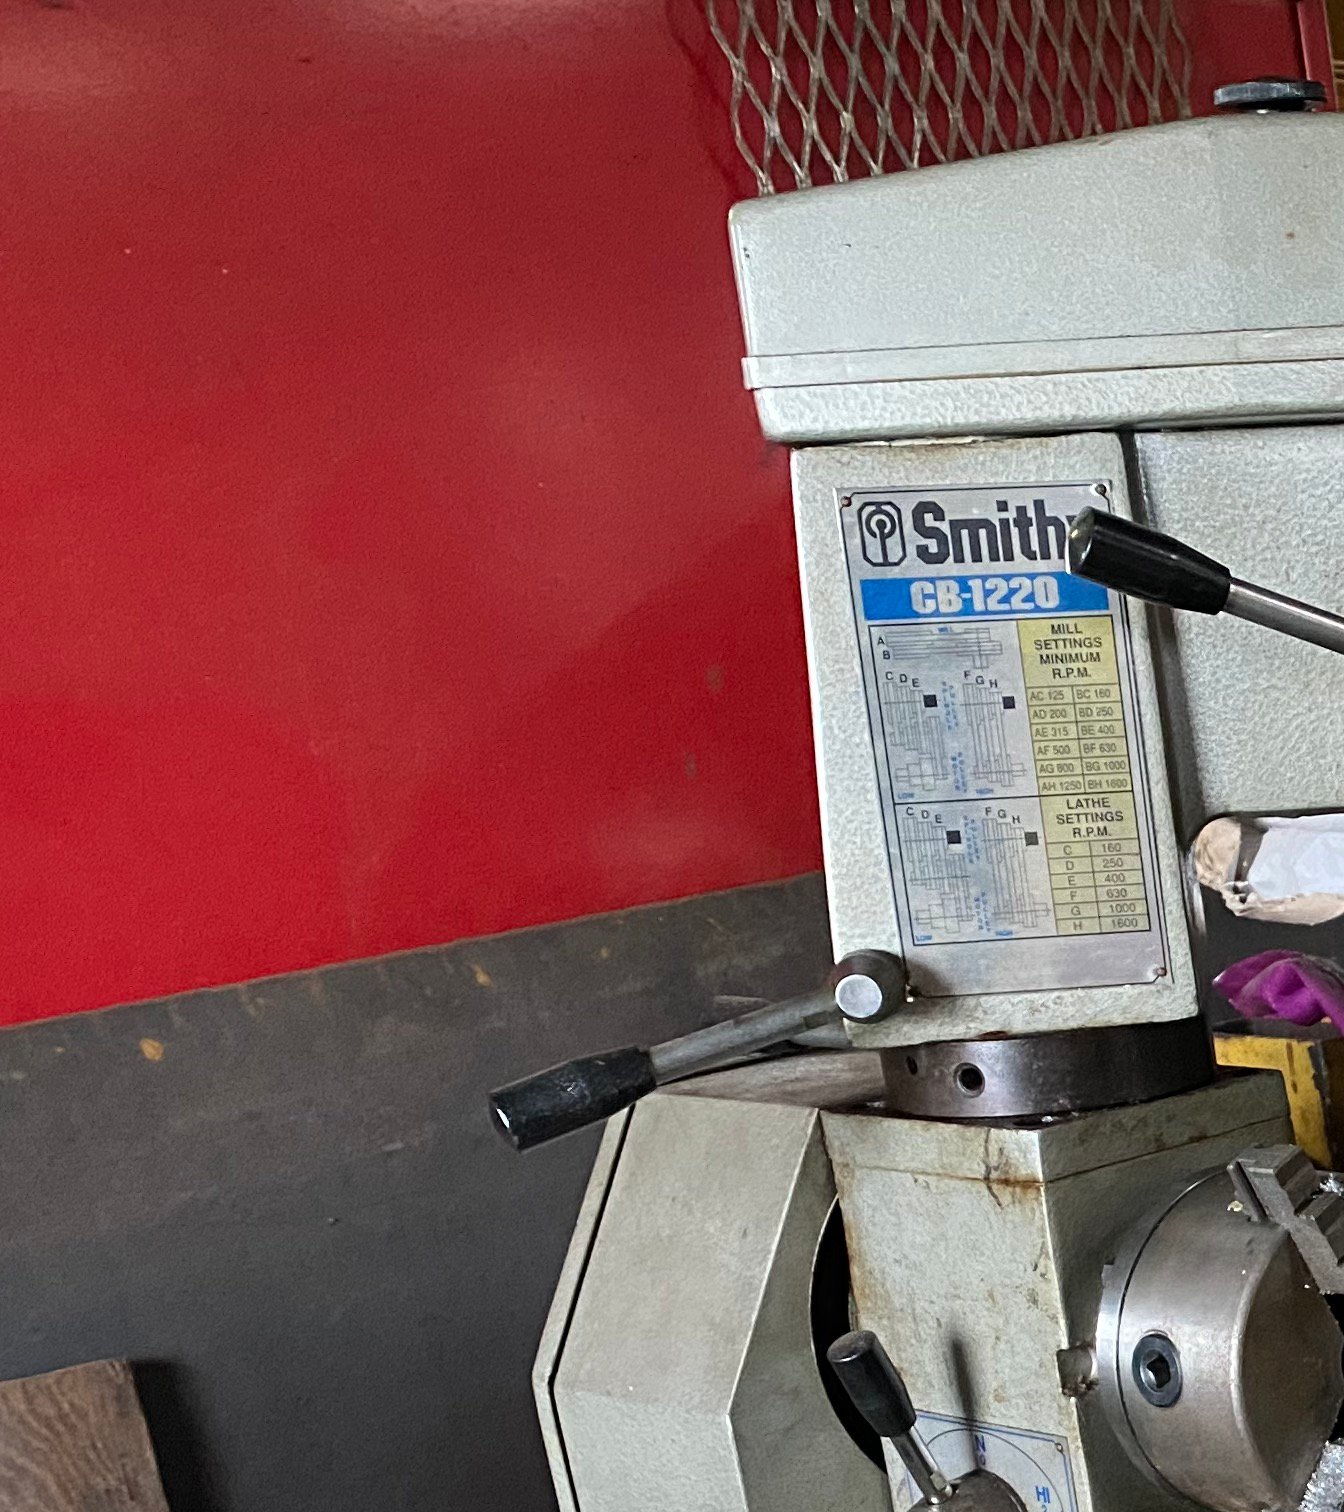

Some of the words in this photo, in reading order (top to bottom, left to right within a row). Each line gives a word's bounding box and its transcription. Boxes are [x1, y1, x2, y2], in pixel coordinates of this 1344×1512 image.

[912, 499, 1076, 564] Smith
[910, 575, 1060, 615] CB-1220
[1051, 623, 1083, 635] MILL
[877, 636, 885, 645] A
[1034, 637, 1103, 650] SETTINGS
[883, 651, 890, 660] B
[1039, 652, 1101, 665] MINIMUM
[886, 671, 894, 680] C
[900, 674, 907, 683] D
[964, 671, 971, 679] F
[1052, 667, 1091, 680] R.P.M.
[912, 678, 919, 688] E
[976, 676, 985, 685] G
[989, 679, 998, 688] H
[1030, 691, 1044, 701] AC
[1077, 689, 1091, 699] BC
[1032, 709, 1047, 719] AD
[1050, 708, 1067, 719] 200
[1079, 707, 1093, 718] BD
[1035, 727, 1048, 737] AE
[1052, 726, 1069, 737] 315
[1081, 725, 1095, 736] BE
[1098, 724, 1115, 735] 400
[1037, 745, 1051, 755] AF
[1052, 744, 1071, 755] 500
[1083, 743, 1096, 754] BF
[1039, 763, 1054, 774] AG
[1085, 761, 1101, 772] BG
[1104, 760, 1126, 771] 1000
[1041, 781, 1056, 792] AH
[1066, 797, 1111, 810] LATHE
[906, 807, 914, 816] C
[921, 810, 930, 819] D
[985, 807, 992, 816] F
[997, 809, 1007, 819] G
[935, 814, 942, 823] E
[1012, 815, 1021, 824] H
[1056, 810, 1124, 825] SETTINGS
[1072, 826, 1112, 838] R.P.M.
[1063, 845, 1073, 855] C
[1066, 861, 1074, 871] D
[1102, 857, 1124, 868] 250
[1067, 876, 1076, 885] E
[1104, 873, 1126, 883] 400
[1070, 891, 1077, 901] F
[1106, 888, 1128, 898] 630
[1071, 905, 1081, 916] G
[1109, 903, 1136, 913] 1000
[1073, 921, 1082, 931] H
[975, 1435, 986, 1452] N
[1035, 1486, 1050, 1504] HI
